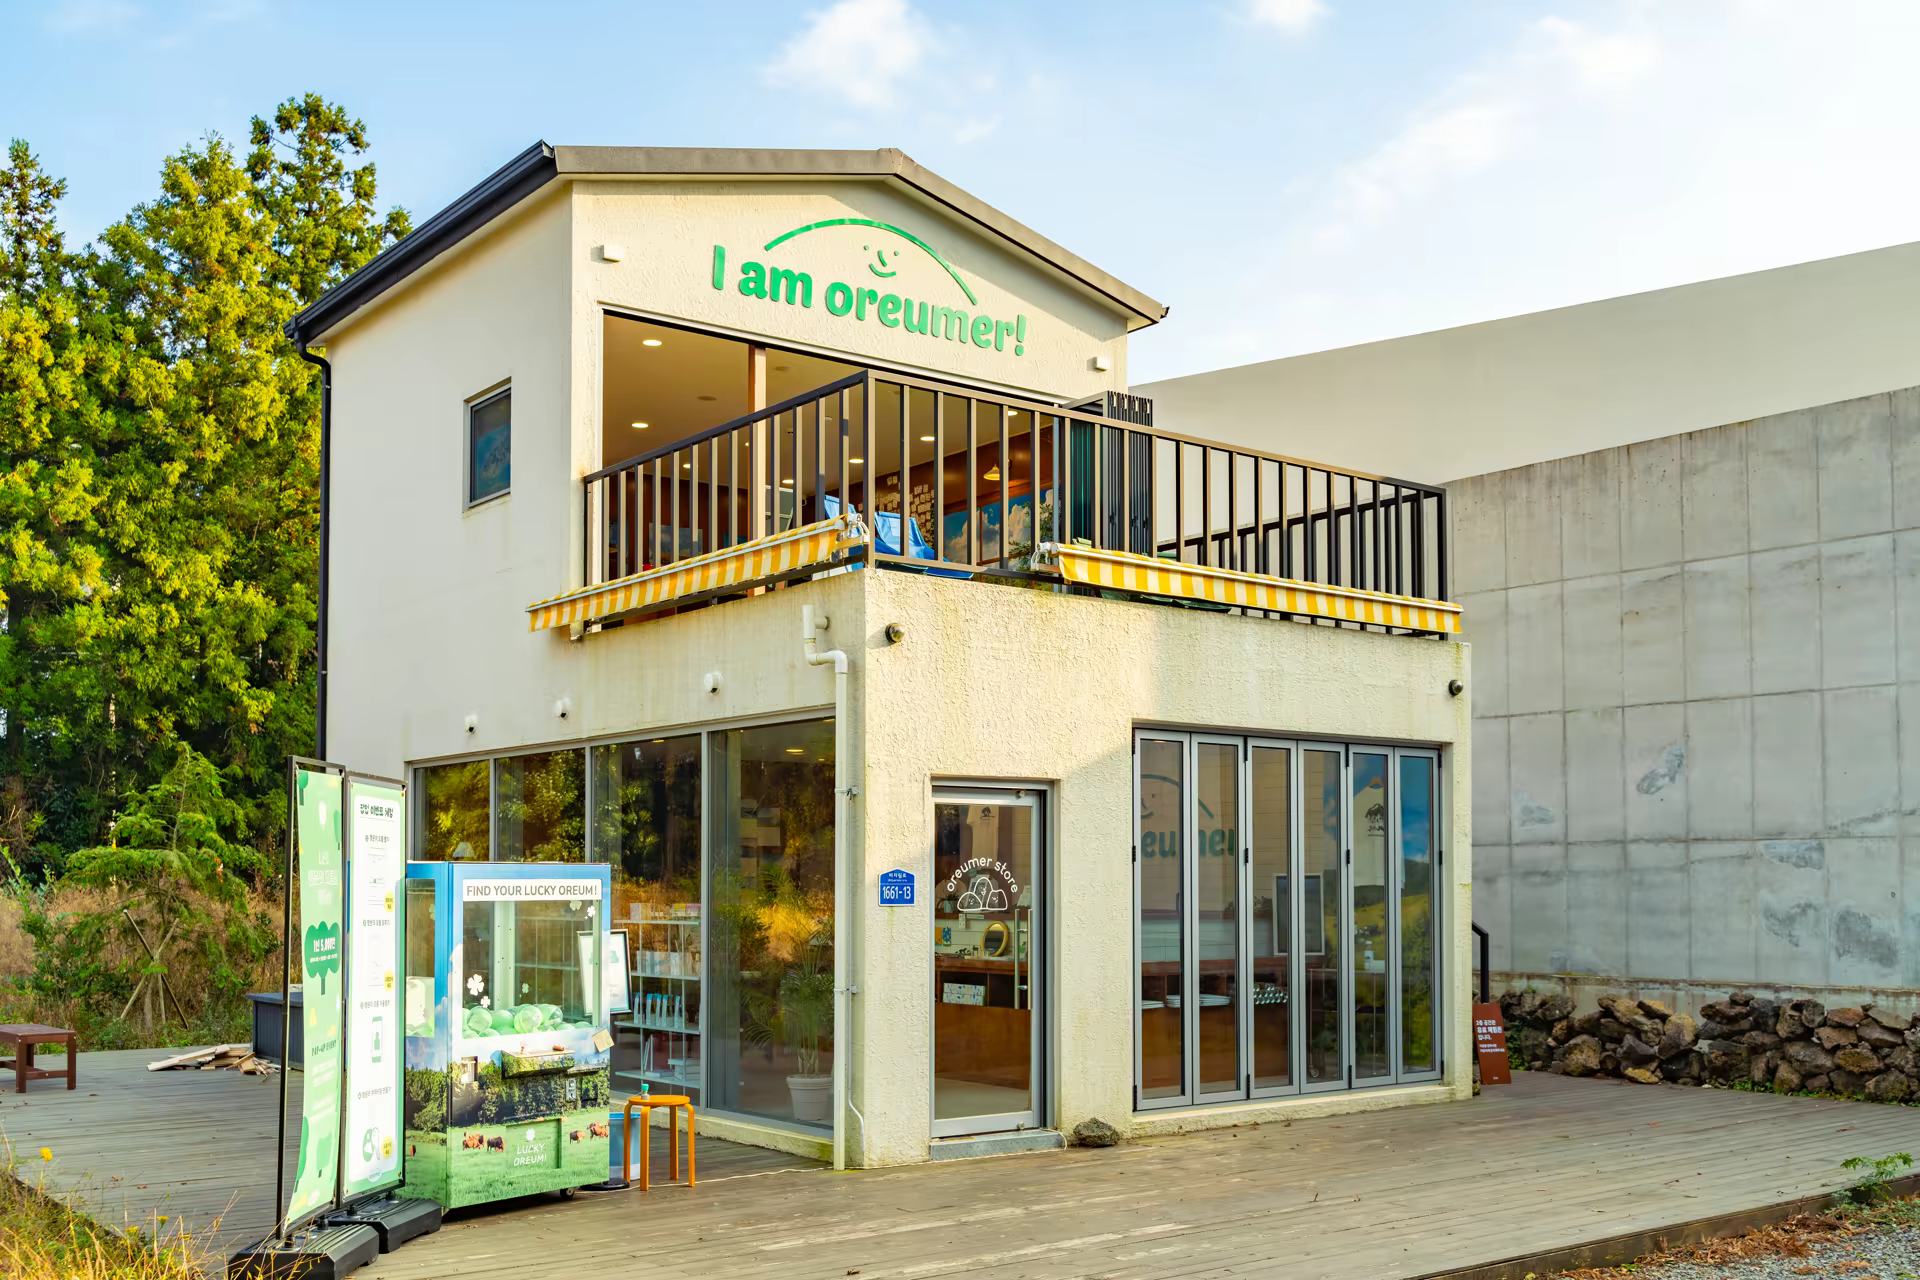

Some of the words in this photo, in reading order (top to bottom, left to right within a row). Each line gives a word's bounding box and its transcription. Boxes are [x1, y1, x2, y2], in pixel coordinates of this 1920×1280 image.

[712, 244, 726, 291] I
[739, 261, 812, 308] am
[824, 281, 1027, 356] oreumer!
[947, 857, 993, 892] oreumer
[994, 861, 1018, 893] store
[466, 885, 491, 896] FIND
[493, 885, 522, 896] YOUR
[524, 885, 556, 896] LUCKY
[882, 886, 911, 900] 1661-13
[516, 1142, 545, 1155] LUCKY
[513, 1153, 547, 1166] OREUM!
